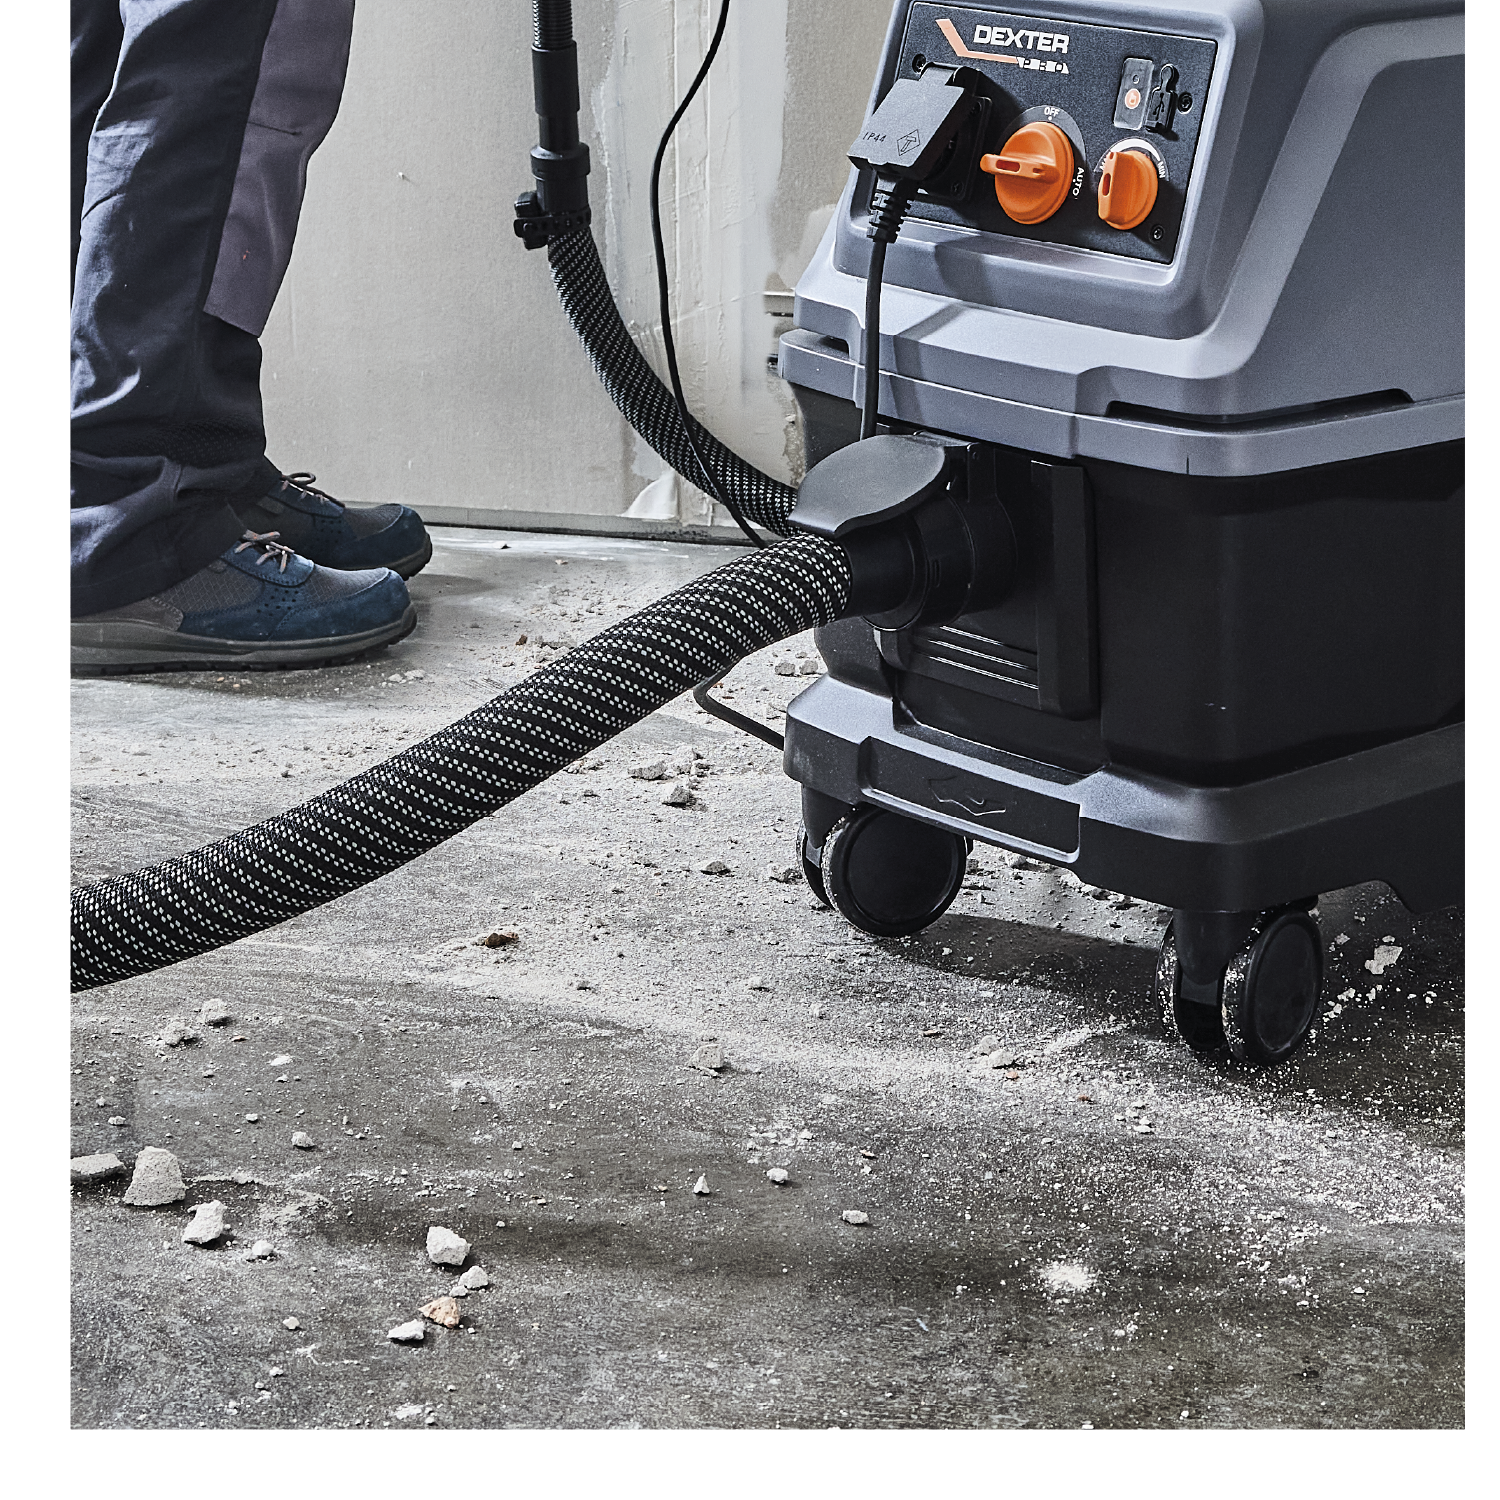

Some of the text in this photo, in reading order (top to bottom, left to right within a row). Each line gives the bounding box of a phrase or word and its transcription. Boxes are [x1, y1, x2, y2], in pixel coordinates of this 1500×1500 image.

[974, 25, 1070, 53] DEXTER
[1019, 57, 1067, 73] PRO
[1043, 107, 1060, 117] OFF
[862, 131, 887, 143] IP44
[1157, 161, 1166, 179] MIN
[1072, 166, 1085, 197] AUTO
